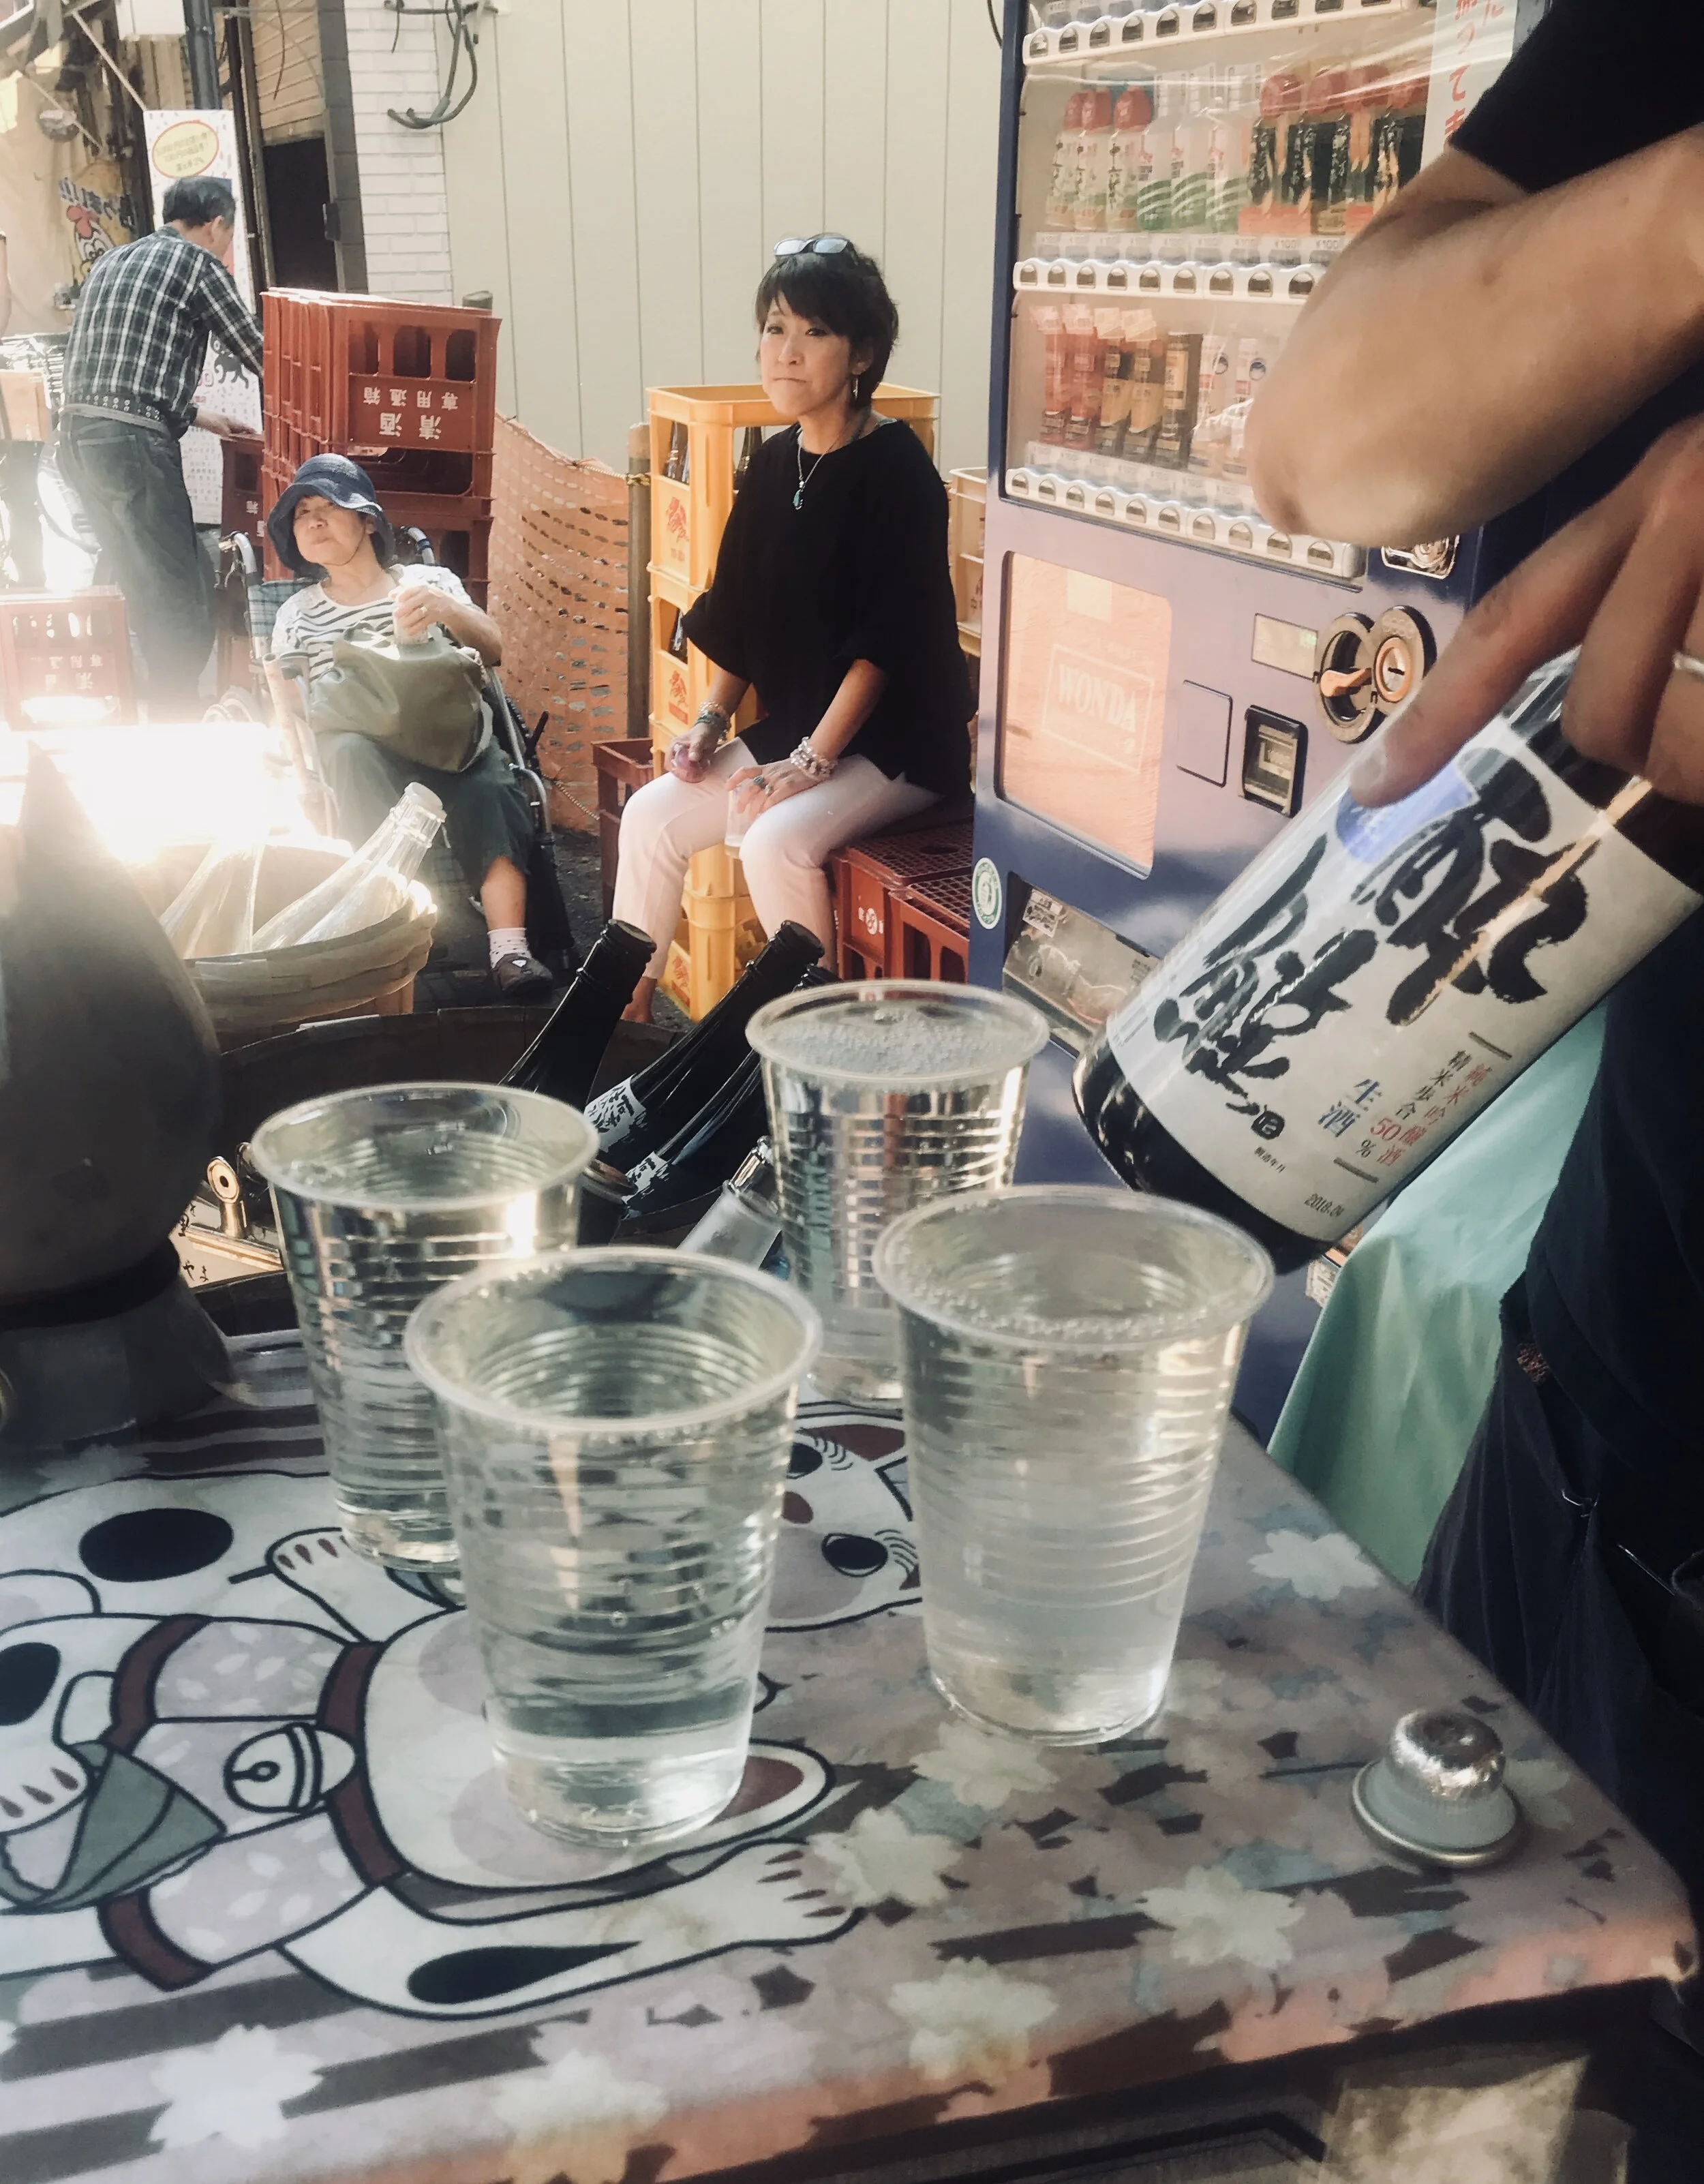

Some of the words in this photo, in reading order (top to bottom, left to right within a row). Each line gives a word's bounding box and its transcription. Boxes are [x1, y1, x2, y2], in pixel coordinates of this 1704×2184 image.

[1315, 239, 1339, 249] ¥100
[379, 412, 442, 440] 清酒
[1058, 663, 1137, 733] WONDA
[1318, 1078, 1382, 1138] 生酒
